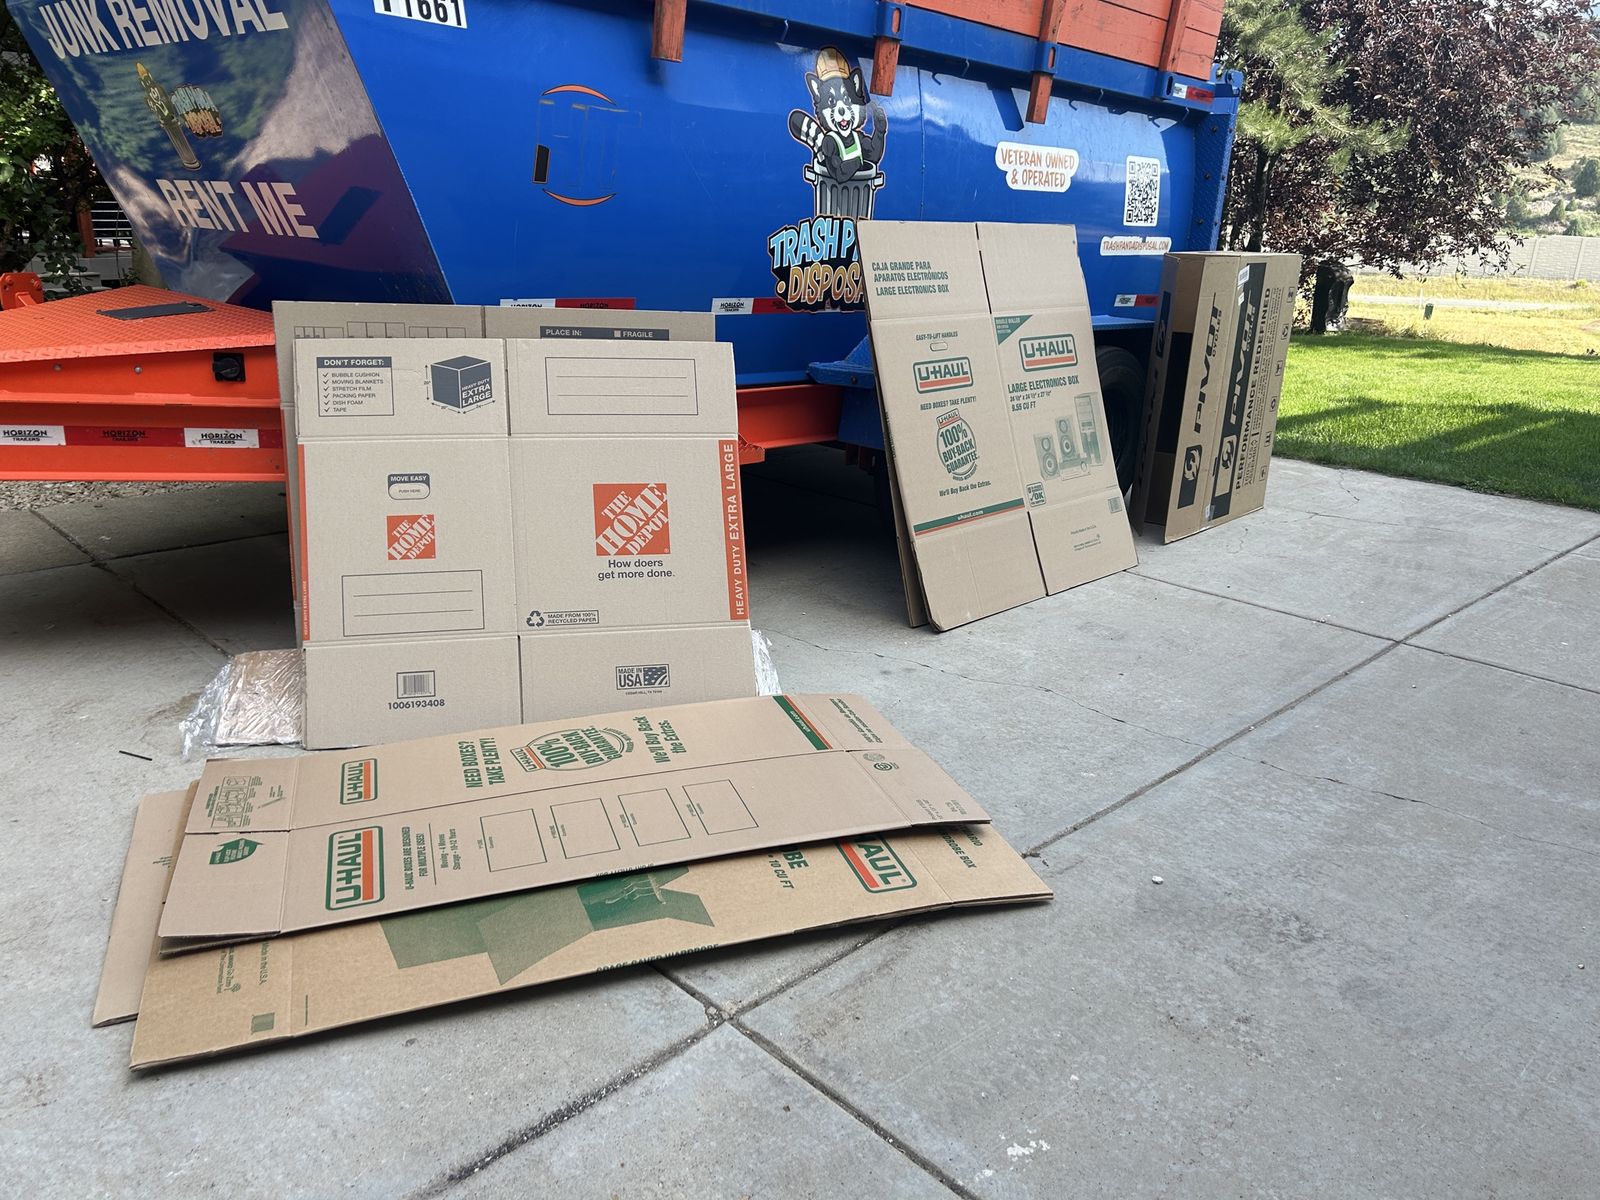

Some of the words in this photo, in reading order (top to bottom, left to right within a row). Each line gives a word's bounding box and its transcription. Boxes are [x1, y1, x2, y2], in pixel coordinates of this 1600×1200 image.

[39, 0, 118, 60] JUNK
[1001, 147, 1042, 167] VETERAN
[1045, 149, 1075, 169] OWNED
[1010, 170, 1018, 186] &
[1021, 170, 1065, 188] OPERATED
[156, 178, 249, 234] RENT
[240, 181, 320, 239] ME
[770, 216, 840, 268] TRASH
[842, 218, 858, 261] P
[872, 262, 888, 272] CAJA
[890, 261, 913, 271] GRANDE
[915, 261, 931, 270] PARA
[874, 272, 906, 283] APARATOS
[876, 286, 896, 296] LARGE
[898, 285, 936, 295] ELECTRONICS
[938, 284, 949, 293] BOX
[546, 329, 571, 337] PLACE
[572, 329, 582, 337] IN:
[623, 330, 653, 338] FRAGILE
[1212, 311, 1222, 357] CYCLES
[1022, 340, 1073, 358] U-HAUL
[1230, 290, 1252, 425] PIVOT
[917, 362, 969, 381] U-HAUL
[1194, 292, 1218, 434] PIVOT
[462, 384, 491, 399] EXTRA
[1008, 381, 1027, 394] LARGE
[1029, 376, 1066, 391] ELECTRONICS
[1067, 375, 1079, 385] BOX
[1236, 381, 1258, 490] PERFORMANCE
[1253, 288, 1270, 375] REDEFINED
[462, 391, 492, 406] LARGE
[920, 403, 931, 411] NEED
[932, 400, 948, 410] BOXES?
[950, 399, 962, 408] TAKE
[938, 411, 959, 424] U-HAUL
[3, 429, 48, 437] HORIZON
[103, 429, 146, 437] HORIZON
[201, 432, 243, 440] HORIZON
[939, 423, 968, 448] 100%
[942, 439, 974, 463] BUY-BACK
[723, 444, 736, 490] LARGE
[947, 453, 978, 474] GUARANTEE
[601, 490, 632, 520] THE
[595, 483, 668, 555] HOME
[727, 494, 740, 540] EXTRA
[387, 514, 435, 560] HOME
[393, 519, 410, 538] THE
[625, 509, 669, 555] DEPOT
[406, 530, 435, 560] DEPOT
[608, 559, 631, 569] How
[634, 558, 663, 568] doers
[731, 546, 742, 575] DUTY
[598, 571, 615, 581] get
[617, 570, 644, 579] more
[647, 569, 675, 578] done.
[736, 580, 745, 615] HEAVY
[619, 674, 642, 687] USA
[388, 699, 445, 710] 1006193408
[633, 716, 653, 732] Back
[480, 737, 501, 762] PLENTY!
[561, 728, 602, 766] BUY-BACK
[581, 726, 623, 760] GUARANTEE
[644, 731, 661, 746] Buy
[670, 741, 687, 753] the
[459, 741, 476, 768] BOXES?
[515, 748, 535, 771] U-HAUL
[537, 736, 579, 768] 100%
[651, 745, 670, 763] We'll
[346, 762, 364, 801] U-HAUL
[464, 769, 483, 788] NEED
[488, 762, 505, 785] TAKE
[418, 846, 426, 865] MULTIPLE
[783, 847, 809, 870] BE
[960, 856, 977, 868] BOX
[336, 832, 361, 904] U-HAUL
[420, 865, 428, 877] FOR
[769, 860, 777, 871] 10
[775, 865, 785, 877] CU
[781, 877, 794, 889] FT
